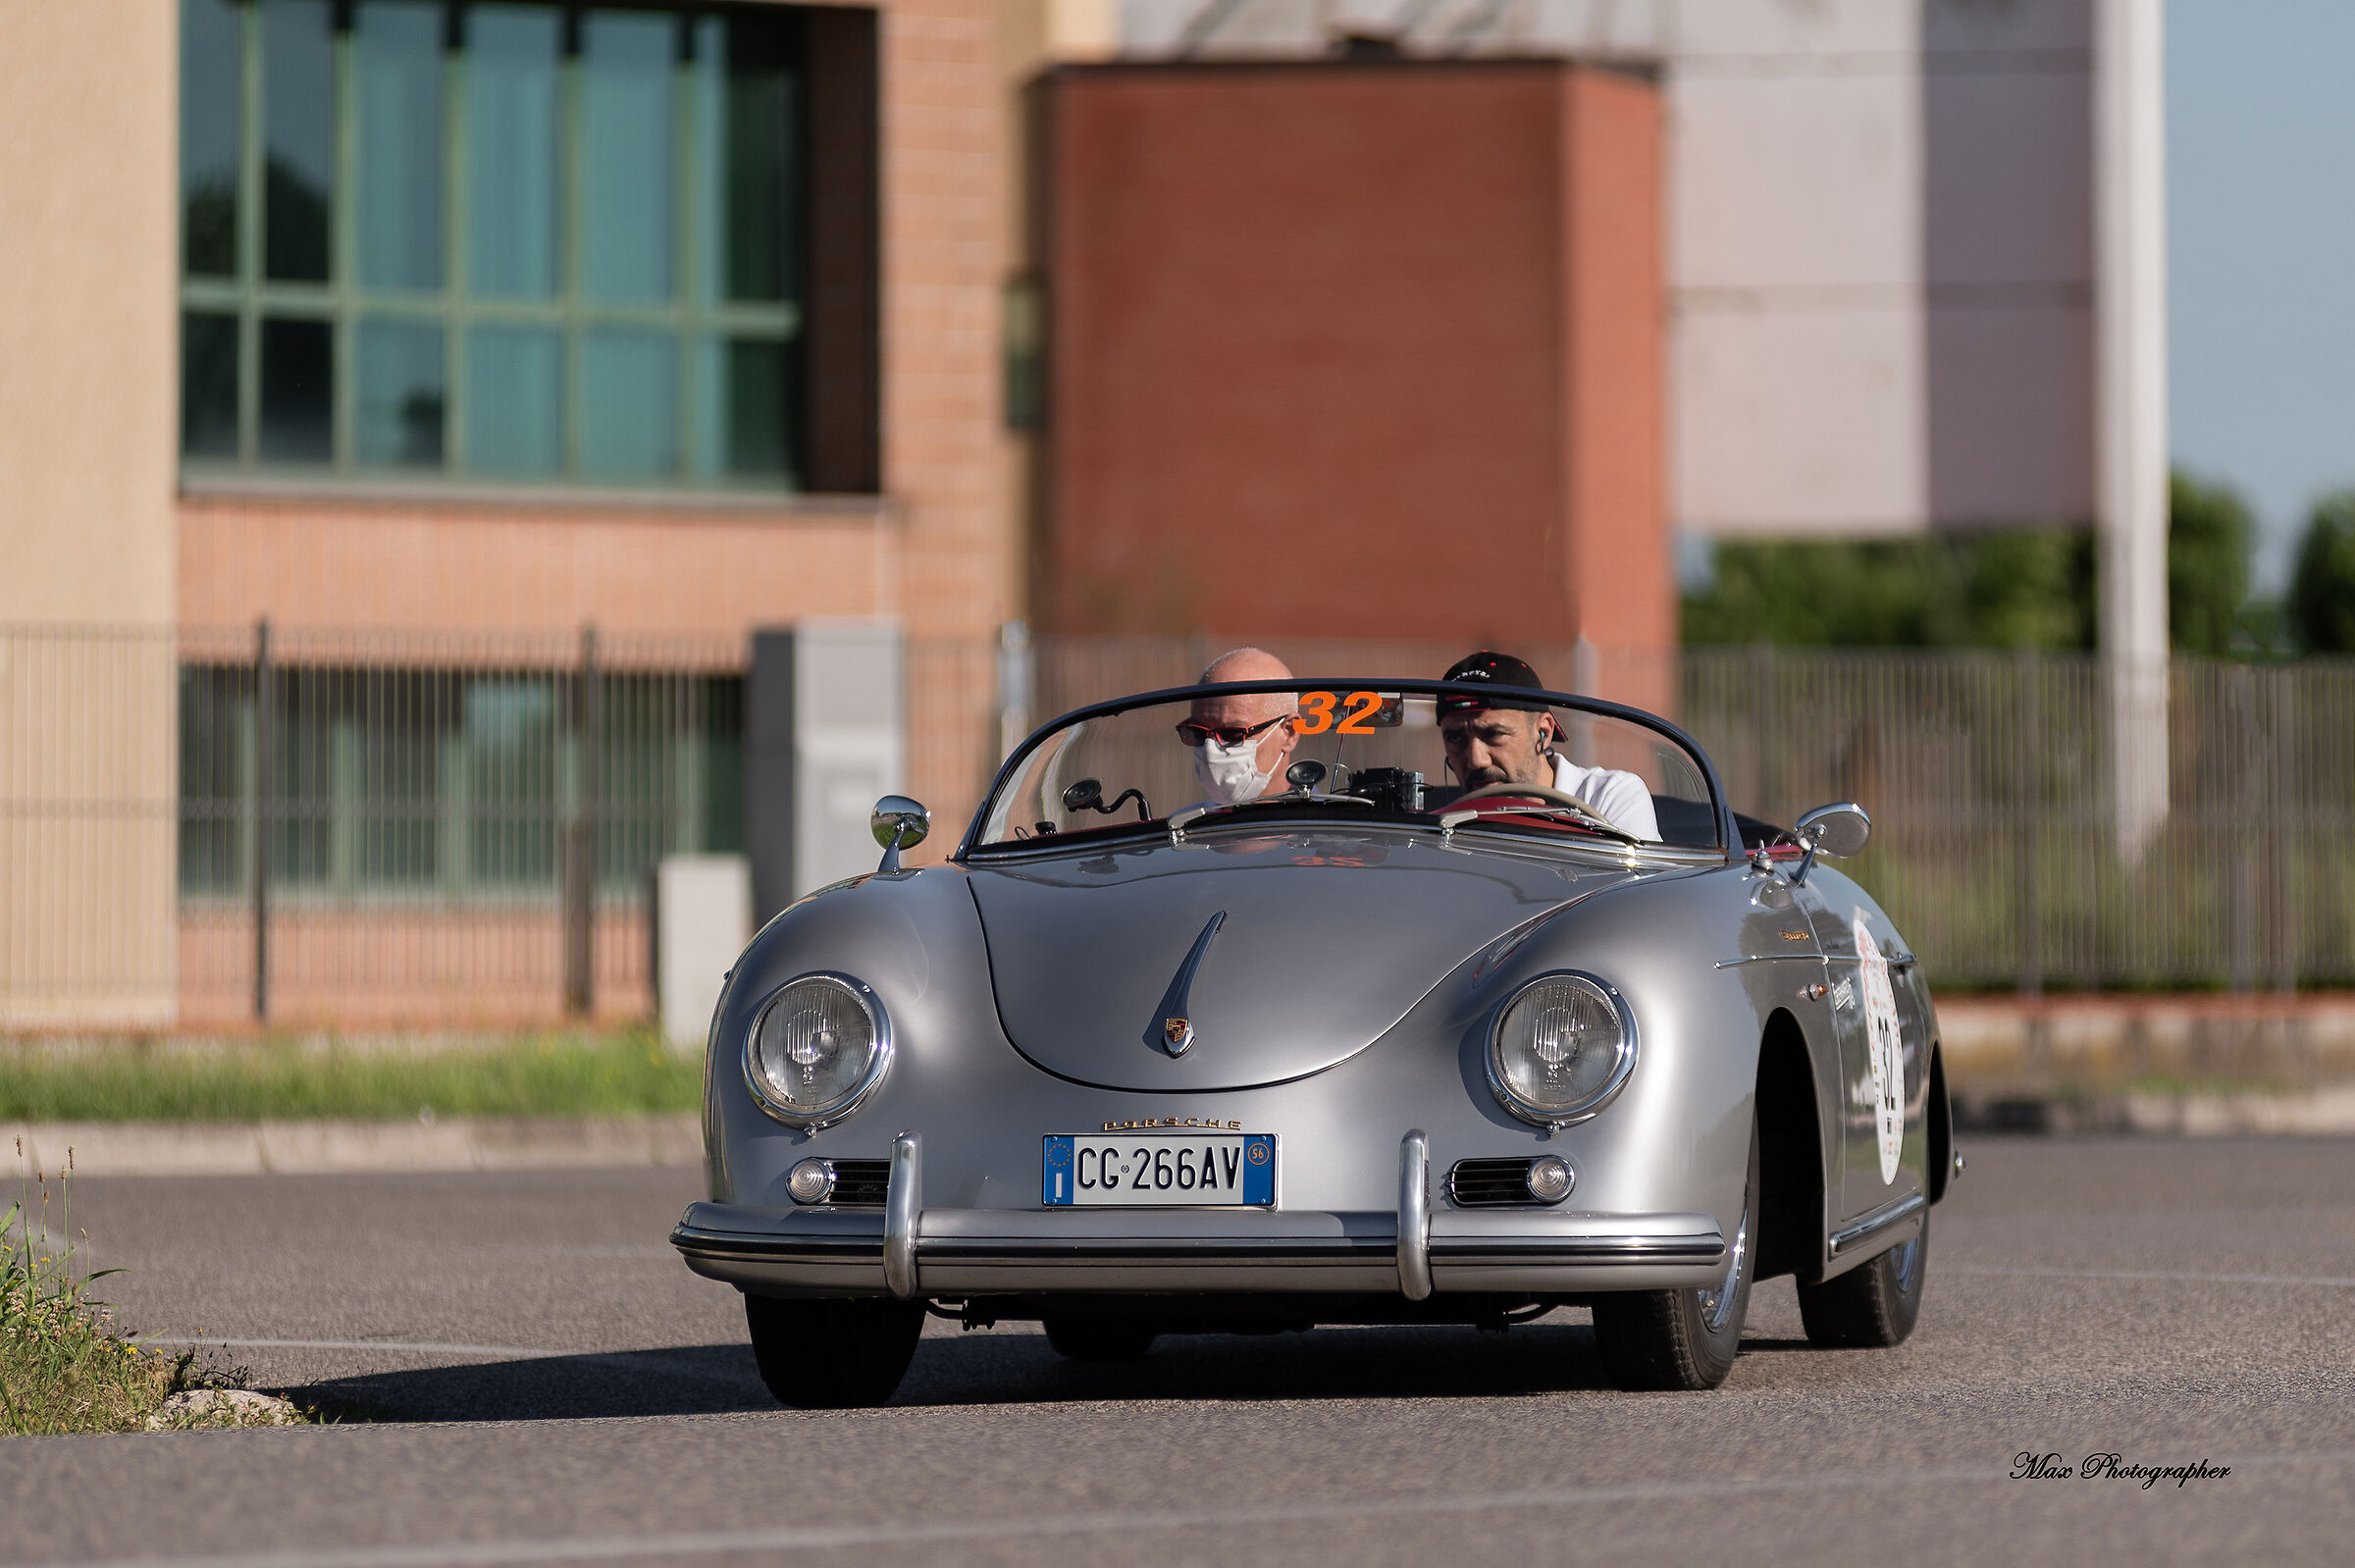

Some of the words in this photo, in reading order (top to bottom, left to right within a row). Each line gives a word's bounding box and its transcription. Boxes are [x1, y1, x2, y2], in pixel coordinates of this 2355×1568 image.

[1292, 691, 1384, 735] 32
[1877, 1016, 1896, 1111] 32
[1103, 1116, 1243, 1131] PORSCHE
[1251, 1148, 1265, 1160] 56
